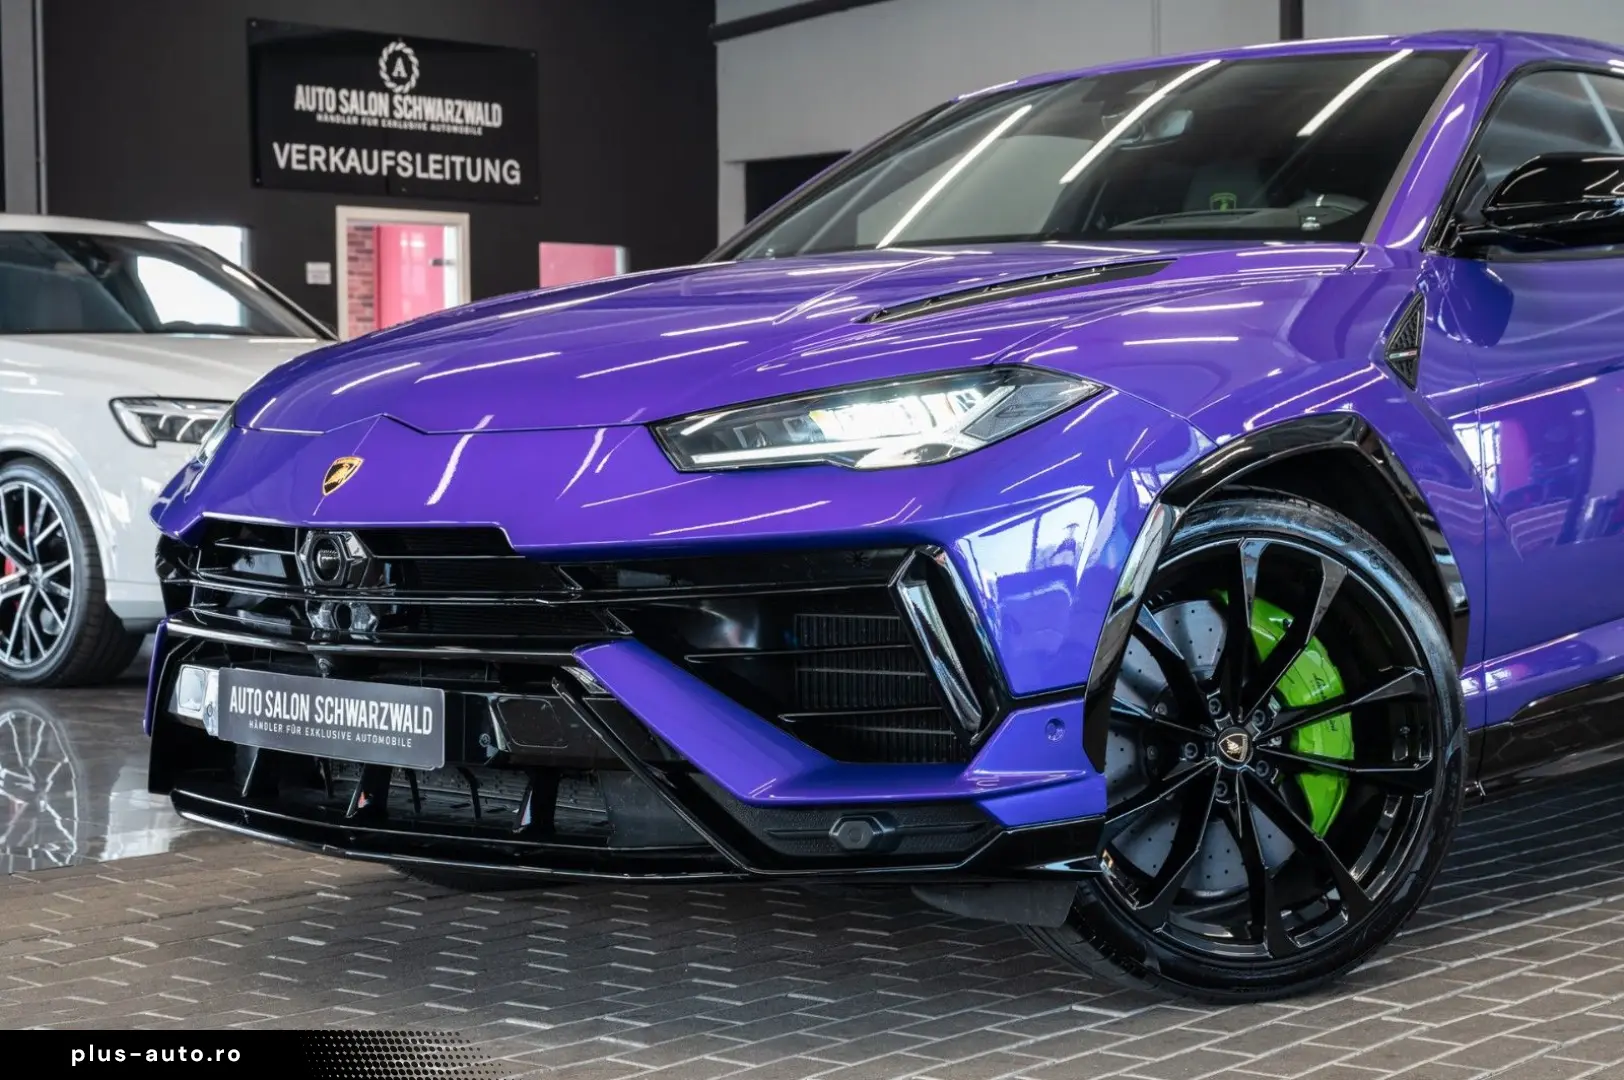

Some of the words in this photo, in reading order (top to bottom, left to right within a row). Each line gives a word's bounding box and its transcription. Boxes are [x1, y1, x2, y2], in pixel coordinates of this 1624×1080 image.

[392, 56, 408, 78] A
[294, 84, 336, 113] AUTO
[339, 89, 389, 118] SALON
[393, 95, 503, 128] SCHWARZWALD
[272, 141, 522, 186] VERKAUFSLEITUNG
[229, 685, 263, 716] AUTO
[265, 689, 309, 722] SALON
[314, 695, 433, 735] SCHWARZWALD
[249, 719, 283, 733] HÄNDLER
[286, 723, 301, 736] FÜR
[305, 728, 352, 741] EXKLUSIVE
[355, 734, 412, 748] AUTOMOBILE
